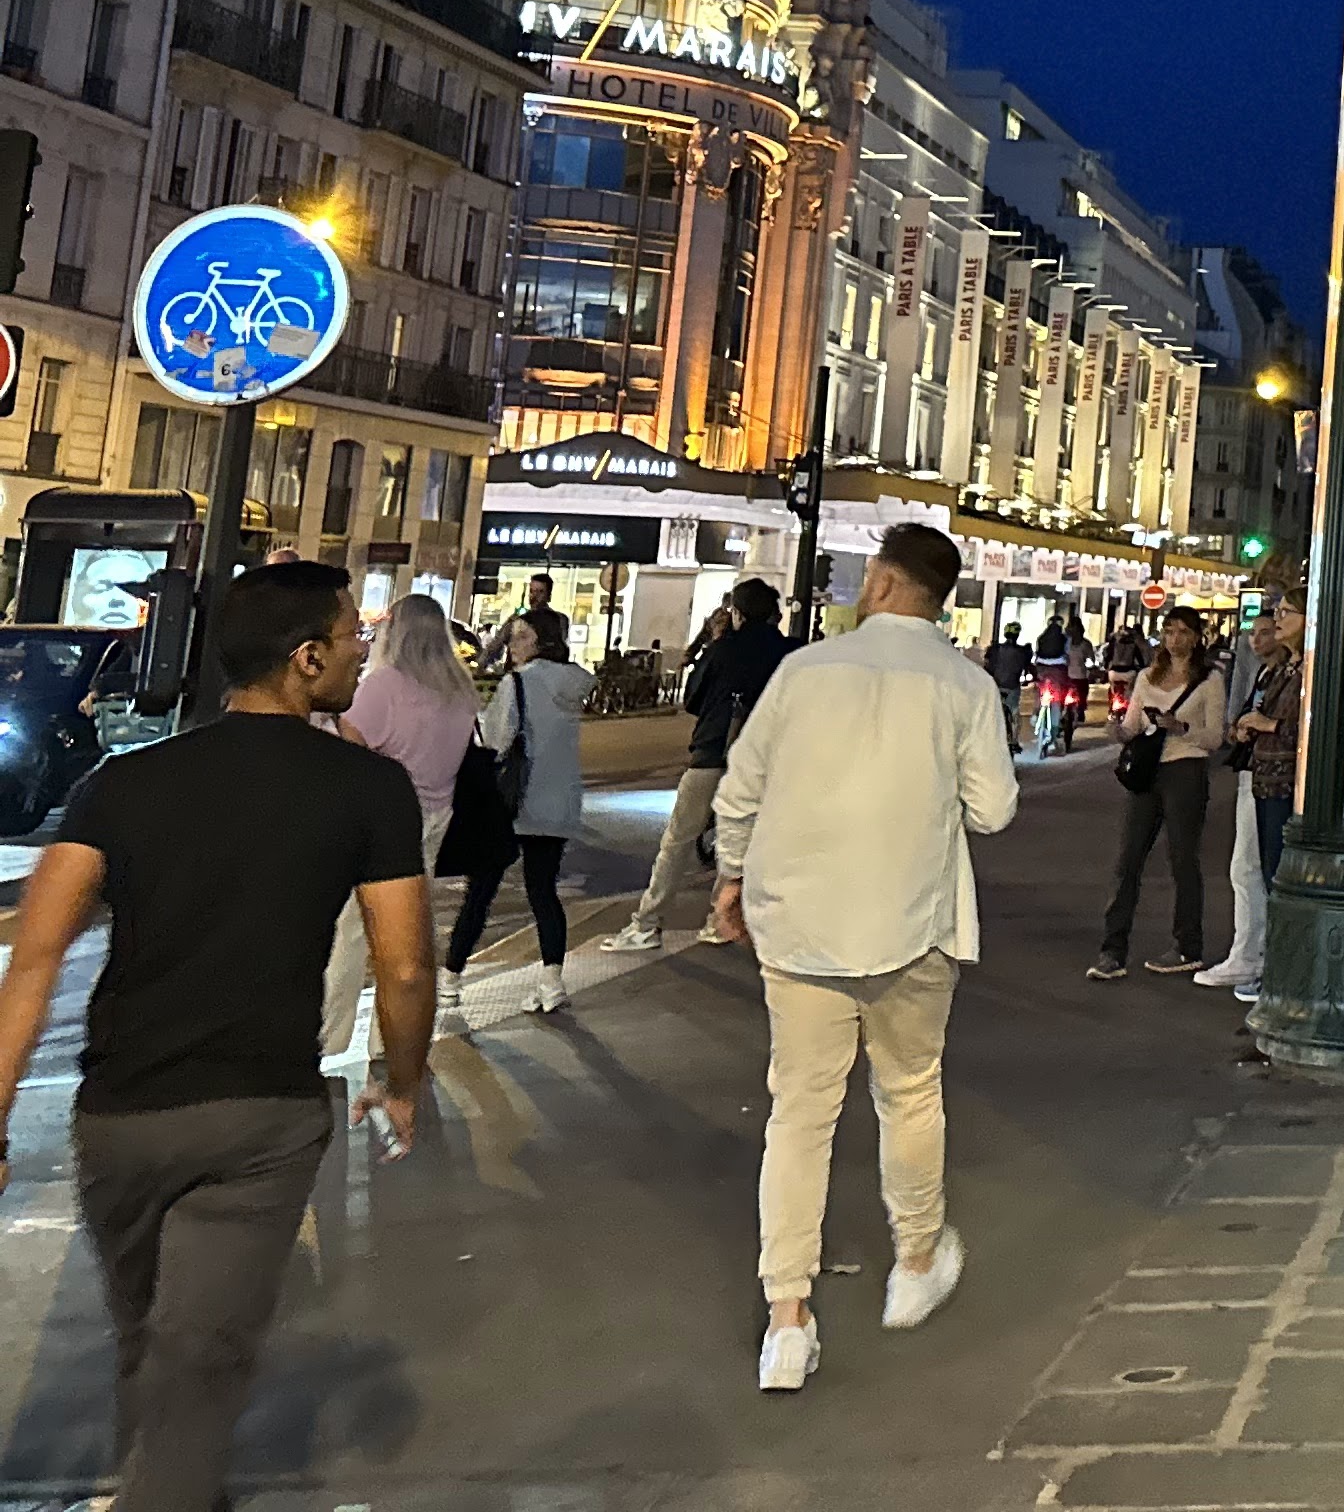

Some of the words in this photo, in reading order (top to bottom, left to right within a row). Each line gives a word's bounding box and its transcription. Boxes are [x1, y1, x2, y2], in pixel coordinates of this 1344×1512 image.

[623, 15, 786, 84] MARAIS
[712, 99, 737, 124] DE
[902, 226, 919, 265] TABLE
[963, 257, 979, 294] TABLE
[897, 280, 913, 317] PARIS
[1008, 288, 1022, 323] TABLE
[959, 306, 974, 341] PARIS
[1004, 334, 1018, 366] PARIS
[521, 454, 549, 471] LE
[607, 457, 677, 478] MARAIS
